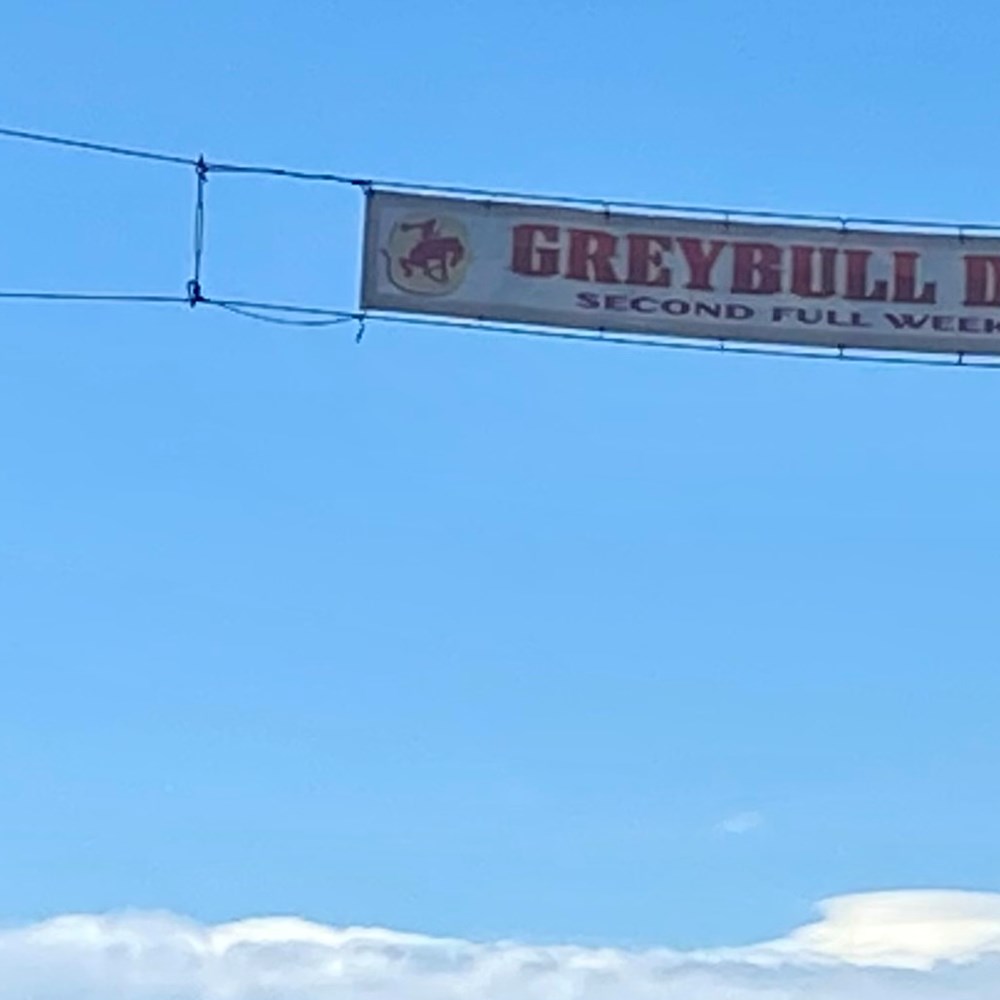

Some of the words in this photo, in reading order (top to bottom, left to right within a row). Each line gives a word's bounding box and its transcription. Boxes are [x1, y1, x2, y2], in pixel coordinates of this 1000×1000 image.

[511, 223, 937, 304] GREYBULL
[577, 291, 755, 320] SECOND
[772, 305, 874, 328] FULL
